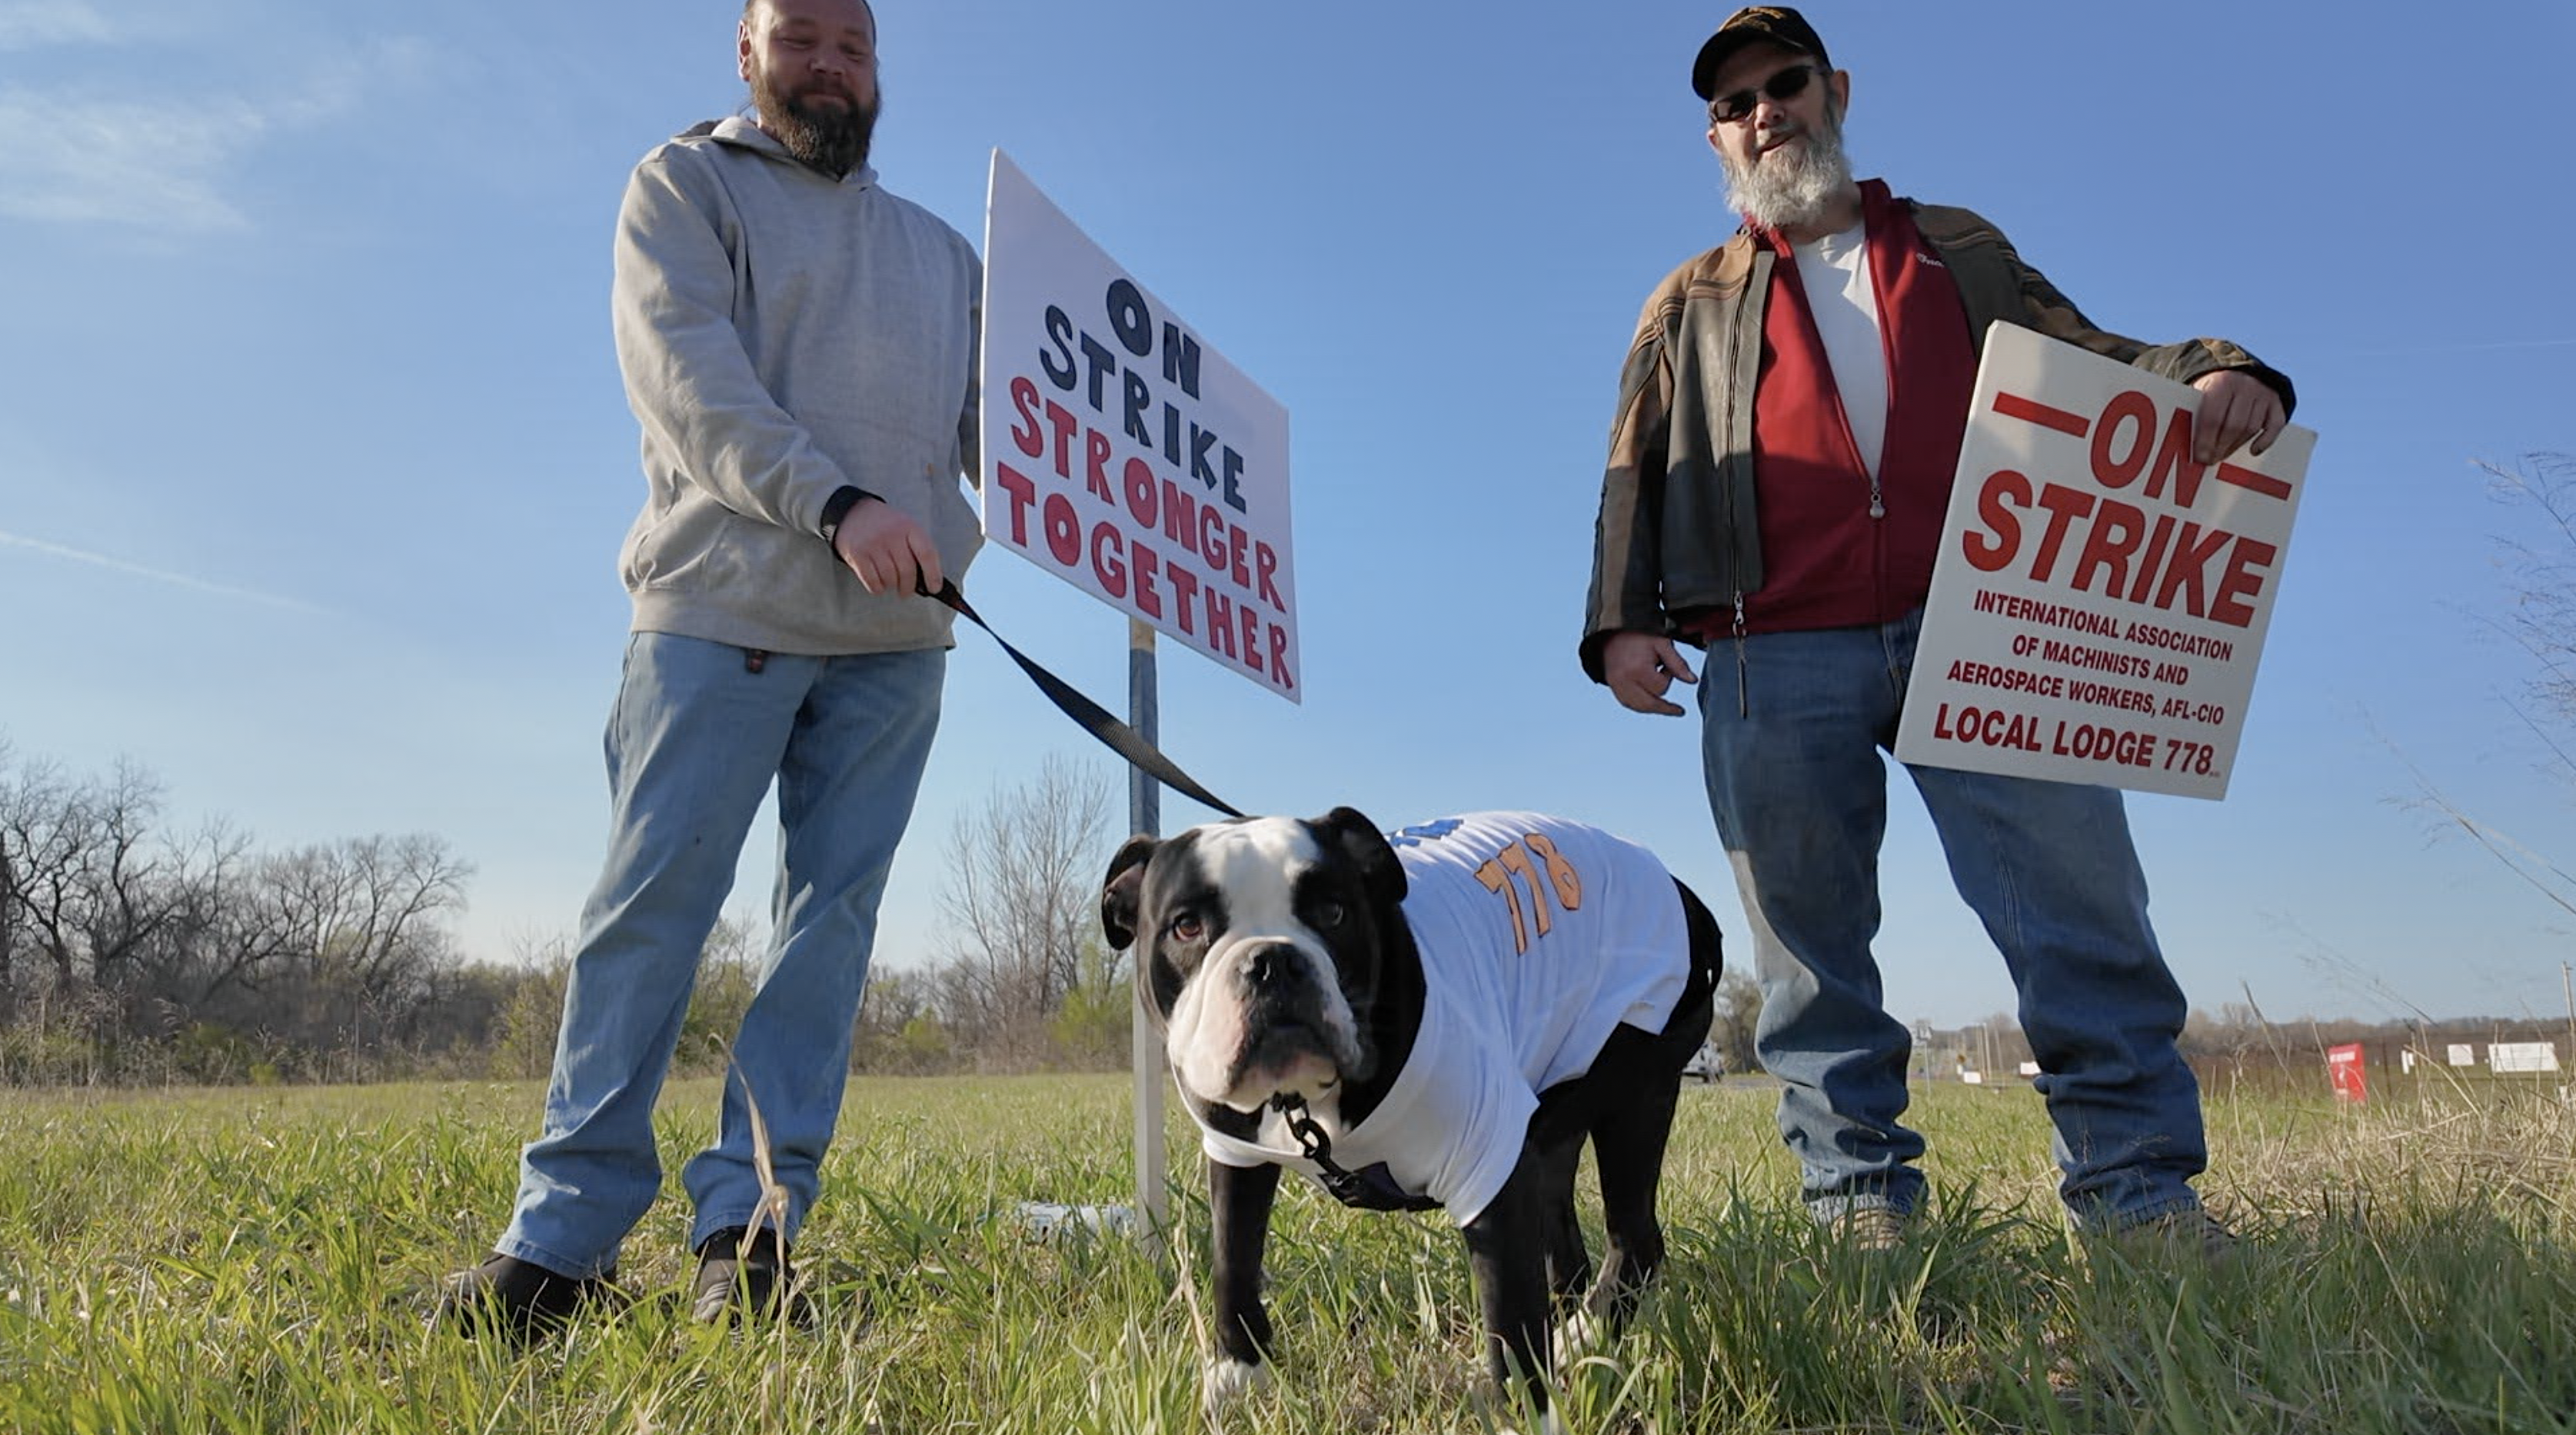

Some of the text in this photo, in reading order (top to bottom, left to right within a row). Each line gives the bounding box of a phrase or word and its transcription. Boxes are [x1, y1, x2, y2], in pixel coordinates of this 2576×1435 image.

[1107, 278, 1200, 401] ON
[1040, 305, 1246, 514] STRIKE
[2090, 390, 2208, 508] ON
[1010, 376, 1286, 614] STRONGER
[1962, 469, 2277, 628] STRIKE
[997, 460, 1293, 690] TOGETHER
[1974, 589, 2233, 661] INTERNATIONAL ASSOCIATION
[1947, 660, 2225, 725] AEROSPACE WORKERS, AFL-CIO
[2012, 634, 2188, 685] OF MACHINISTS AND
[1934, 703, 2214, 776] LOCAL LODGE 778
[1473, 832, 1581, 957] 778
